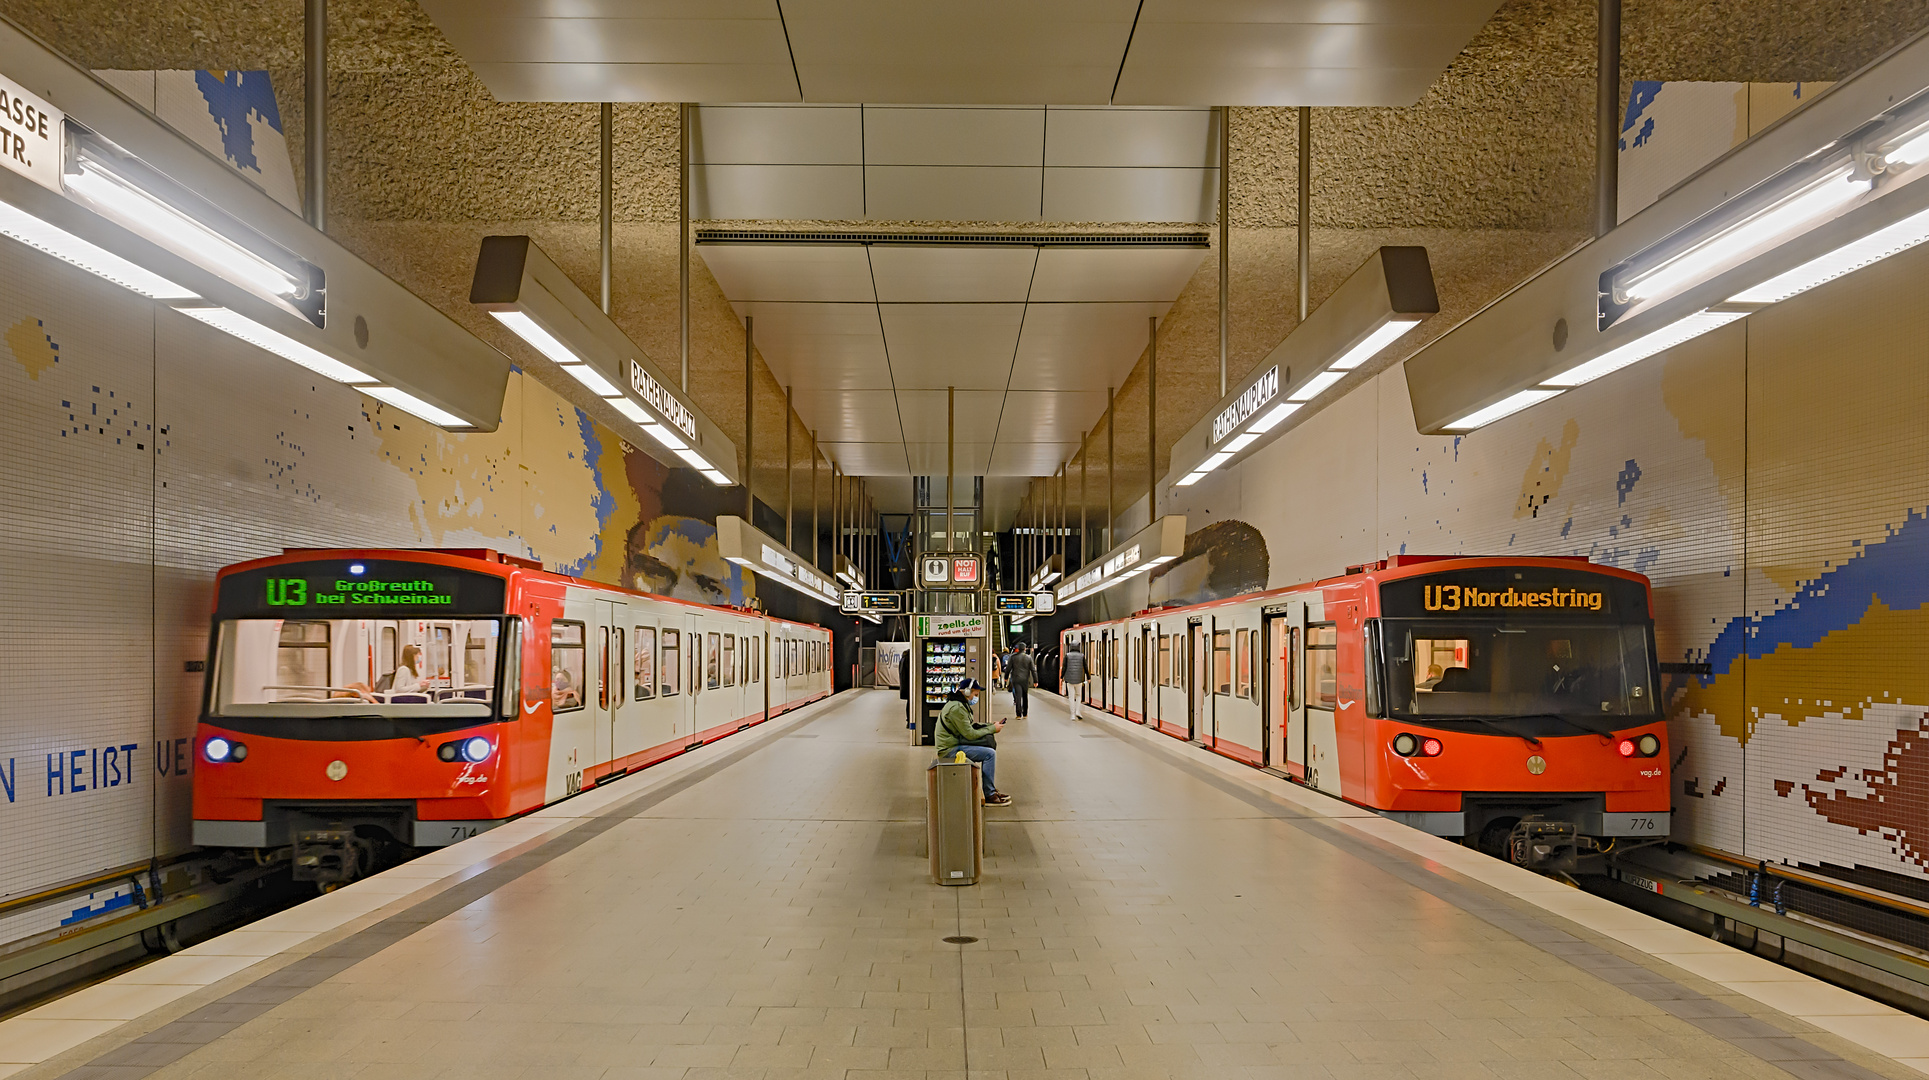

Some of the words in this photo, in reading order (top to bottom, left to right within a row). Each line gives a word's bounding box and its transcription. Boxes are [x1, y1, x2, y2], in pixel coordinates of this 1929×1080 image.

[633, 361, 695, 438] RATHENAUPLATZ
[1214, 366, 1277, 442] RATHENAUPLATZ
[267, 578, 307, 606] U3
[335, 580, 434, 592] Großreuth
[316, 592, 345, 604] bei
[352, 592, 452, 605] Schweinau
[864, 599, 869, 608] 1
[1026, 600, 1033, 608] 2
[1424, 585, 1461, 611] U3
[1464, 588, 1602, 611] Nordwestring
[937, 618, 982, 630] zoells.de
[47, 743, 138, 797] HEIßT
[157, 737, 196, 778] VE
[1640, 767, 1662, 778] vag.de
[566, 771, 582, 796] VAG
[1631, 818, 1655, 830] 776
[451, 826, 477, 839] 714
